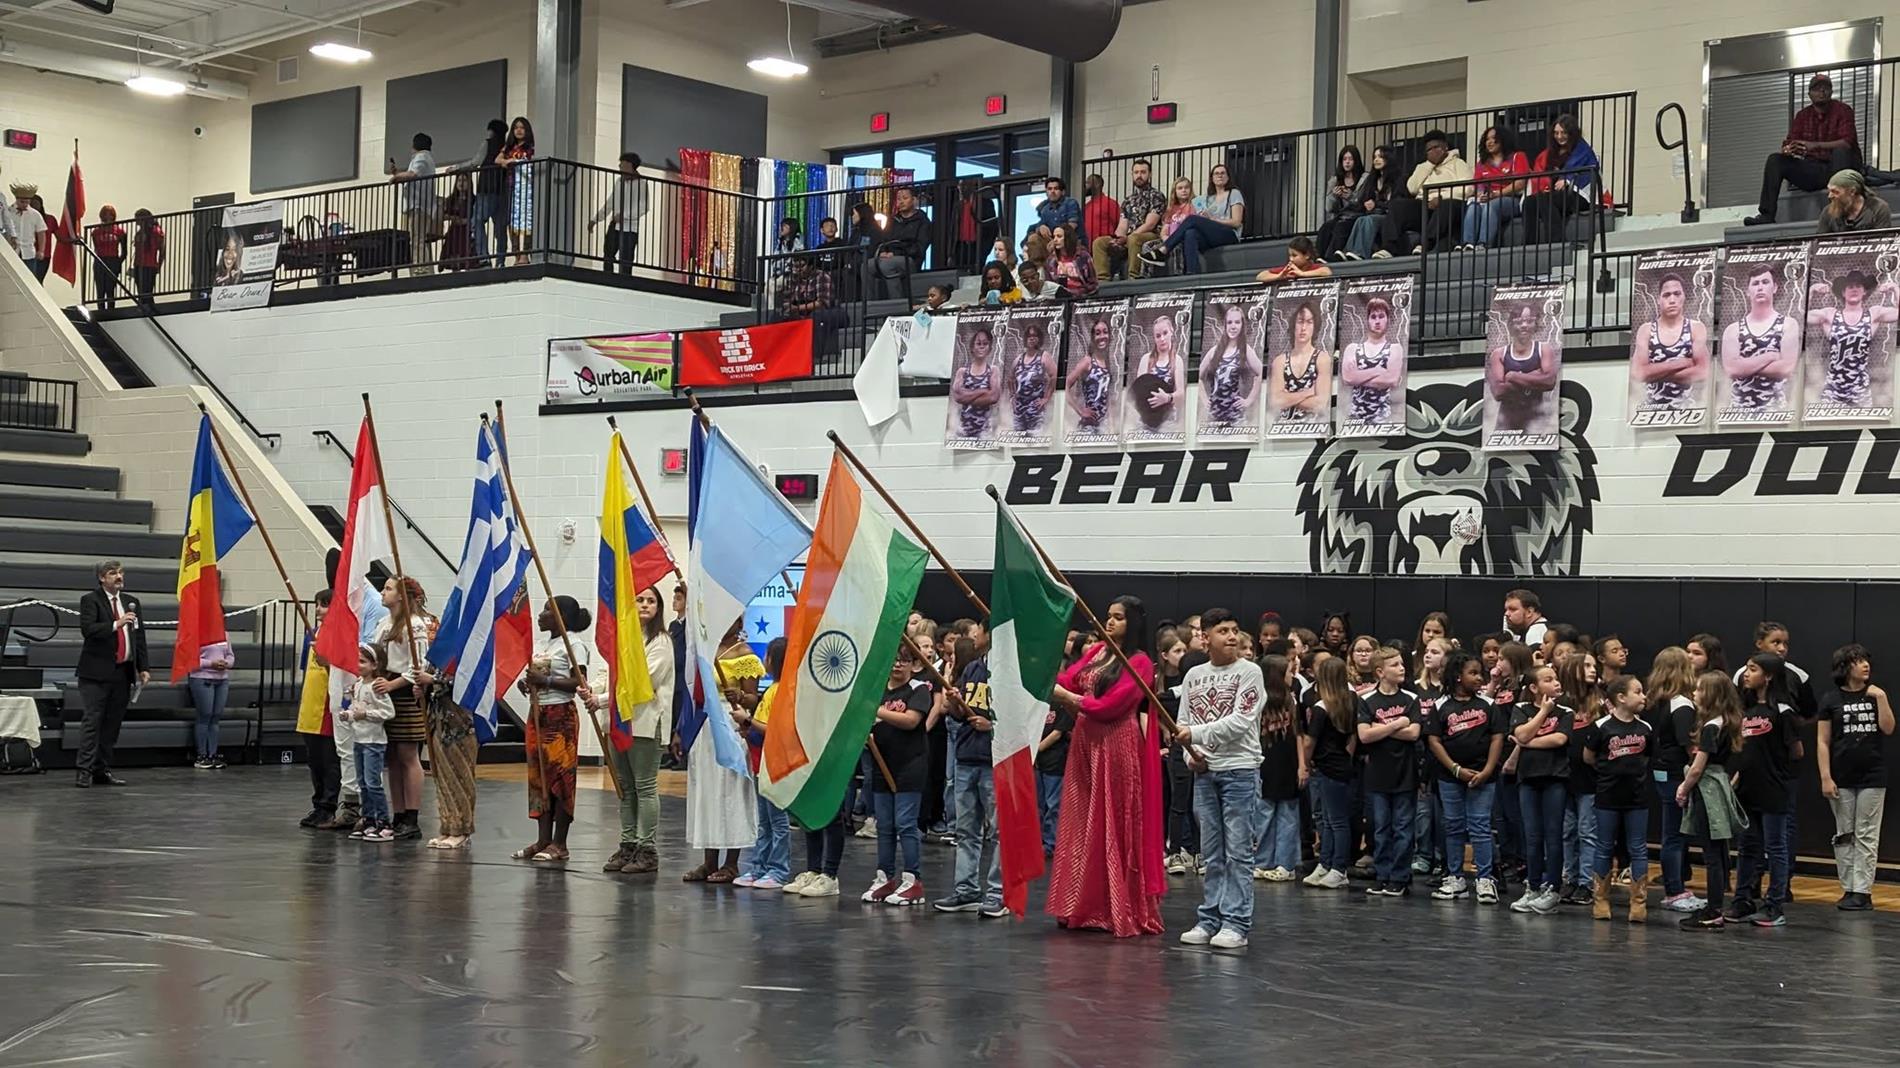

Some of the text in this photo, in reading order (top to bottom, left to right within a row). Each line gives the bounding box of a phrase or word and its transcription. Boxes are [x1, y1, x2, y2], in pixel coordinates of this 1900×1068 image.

[1816, 244, 1898, 255] WRESTLING
[1727, 252, 1806, 263] WRESTLING
[1638, 258, 1713, 270] WRESTLING
[216, 288, 238, 300] Bear
[1276, 288, 1338, 298] WRESTLING
[1494, 290, 1564, 301] WRESTLING
[1135, 299, 1191, 309] WRESTLING
[1209, 295, 1267, 304] WRESTLING
[1075, 305, 1128, 314] WRESTLING
[958, 315, 1010, 323] WRESTLING
[1011, 311, 1062, 319] WRESTLING
[597, 366, 668, 386] urban Air
[1631, 408, 1706, 425] BOYD
[1718, 411, 1795, 421] WILLIAMS
[1805, 408, 1893, 417] ANDERSON
[1198, 427, 1258, 435] SELIGMAN
[1269, 423, 1330, 434] BROWN
[1341, 424, 1405, 435] NUNEZ
[1064, 434, 1120, 443] FRANKLIN
[1486, 434, 1558, 446] ENYEJI
[945, 440, 1001, 449] GRAYSON
[1004, 448, 1251, 505] BEAR
[1843, 712, 1876, 723] SME
[1843, 723, 1878, 733] SPACE
